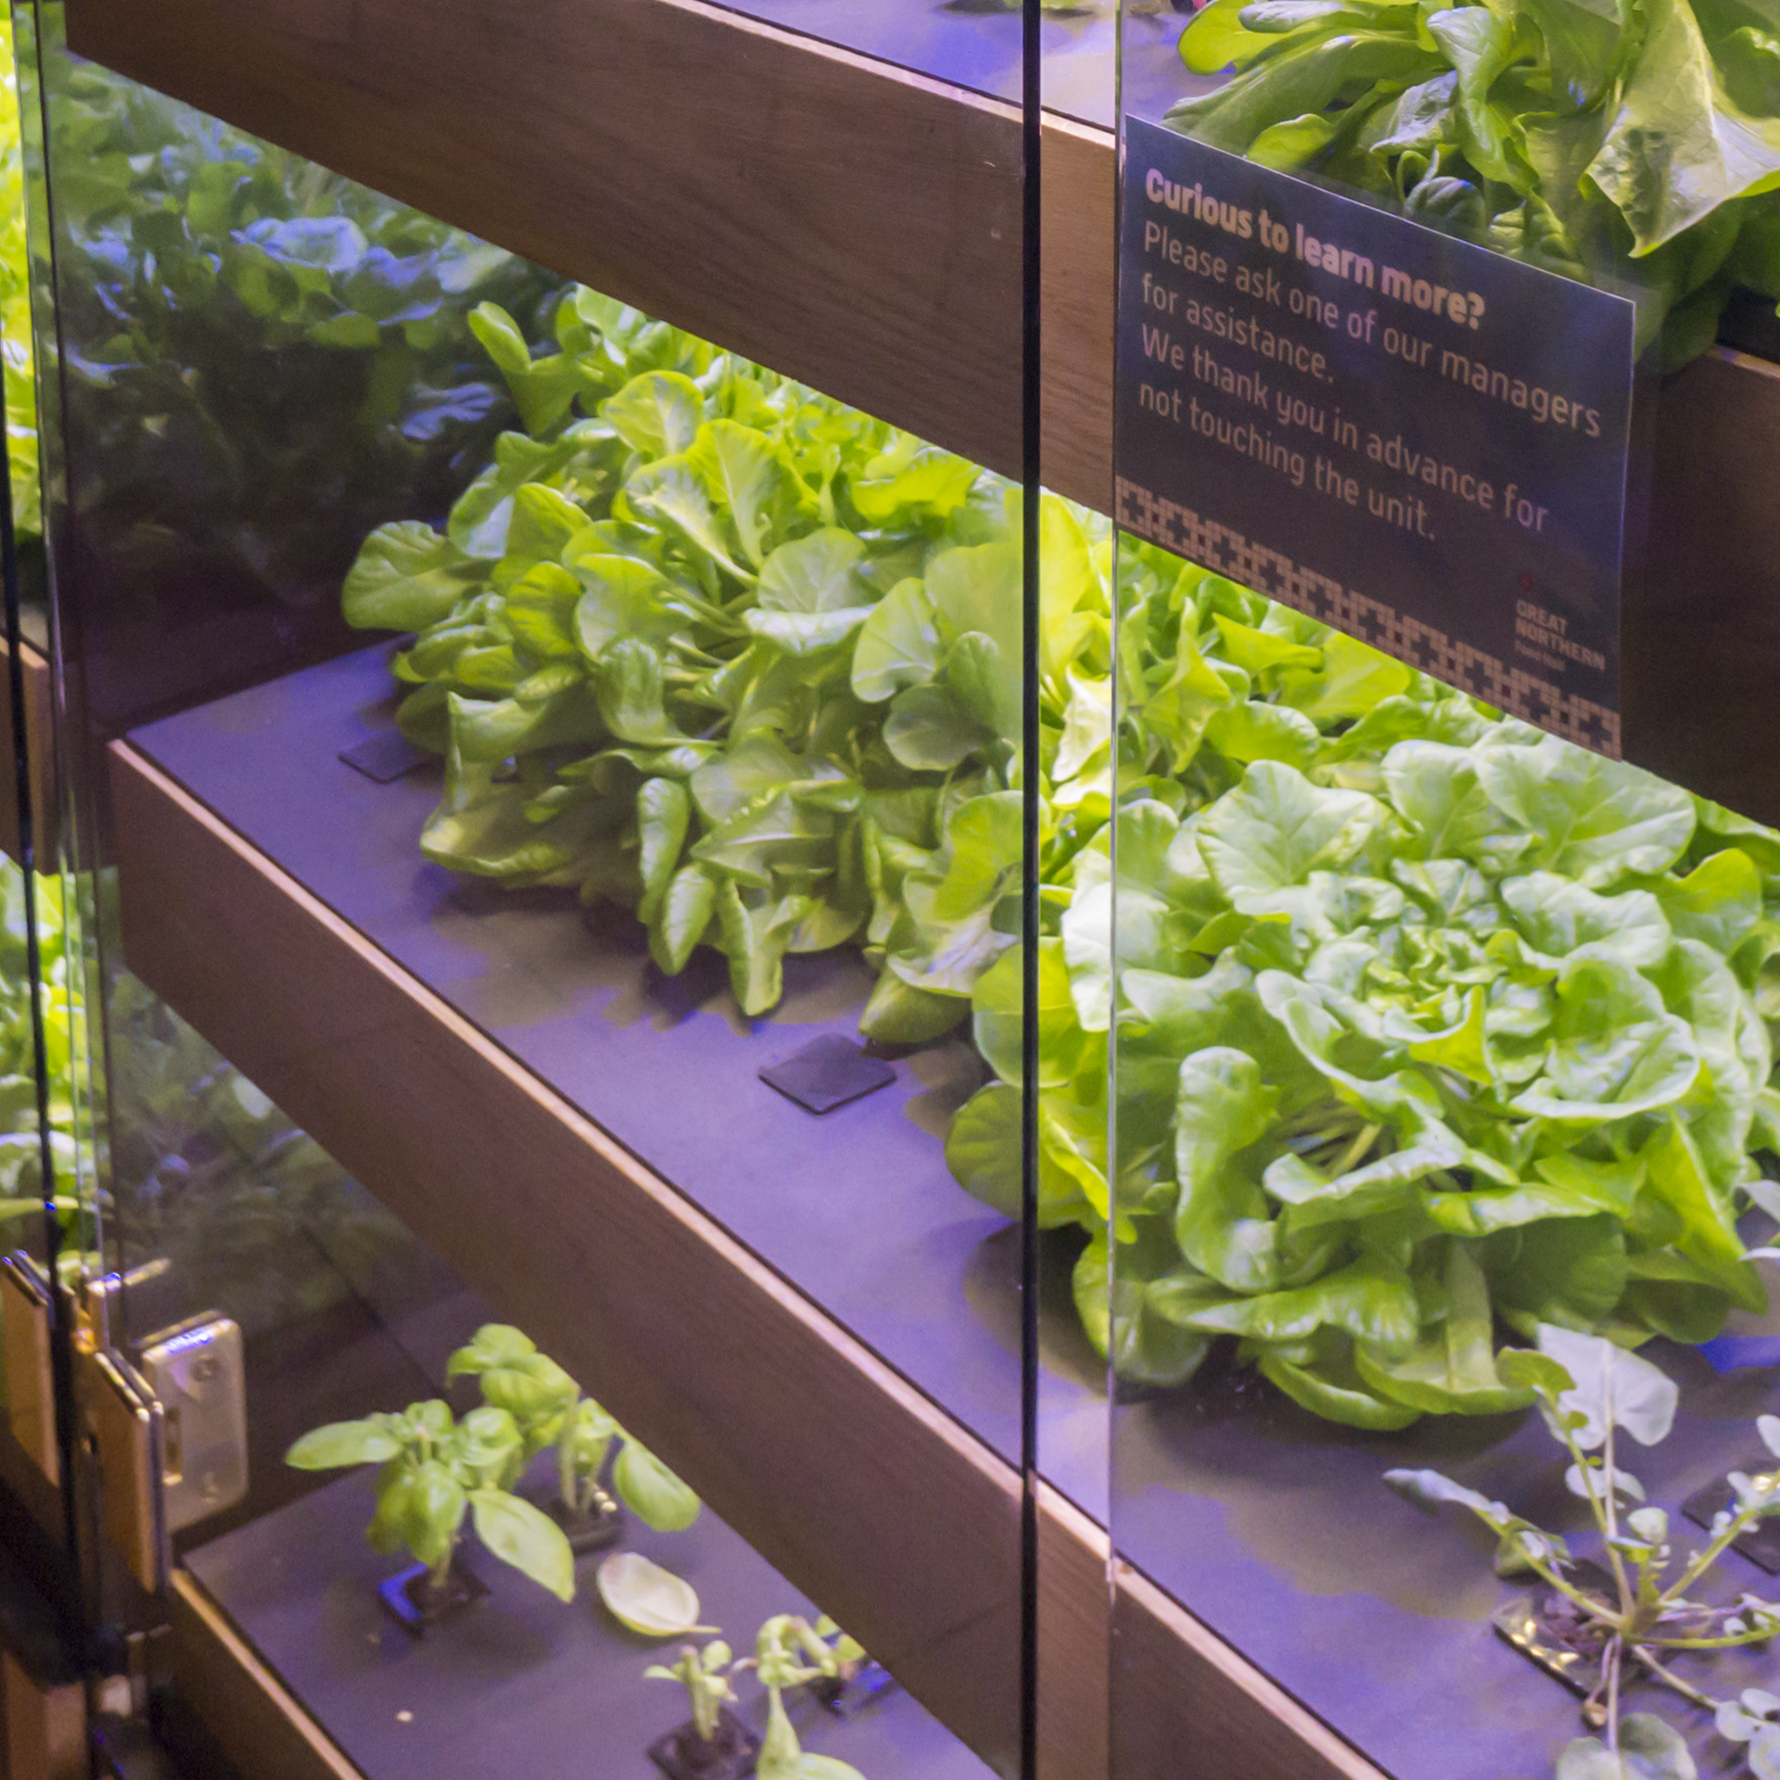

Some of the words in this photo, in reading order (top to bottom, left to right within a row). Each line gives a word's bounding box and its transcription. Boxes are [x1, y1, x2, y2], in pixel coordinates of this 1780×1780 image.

[1142, 272, 1179, 314] for
[1186, 298, 1334, 384] assistance.
[1146, 168, 1253, 239] Curious
[1258, 208, 1290, 254] to
[1295, 222, 1375, 289] learn
[1381, 265, 1486, 331] more?
[1144, 220, 1227, 283] Please
[1235, 265, 1281, 306] ask
[1289, 288, 1339, 329] one
[1347, 308, 1378, 344] of
[1383, 327, 1433, 367] our
[1441, 349, 1601, 438] managers
[1139, 383, 1182, 423] not
[1189, 396, 1306, 487] touching
[1314, 454, 1359, 507] the
[1368, 488, 1436, 541] unit.
[1142, 322, 1185, 370] We
[1192, 344, 1269, 410] thank
[1276, 391, 1325, 435] you
[1333, 406, 1358, 451] in
[1366, 432, 1494, 510] advance
[1504, 481, 1549, 532] for
[1514, 616, 1606, 672] NORTHERN
[1516, 599, 1568, 637] GREAT
